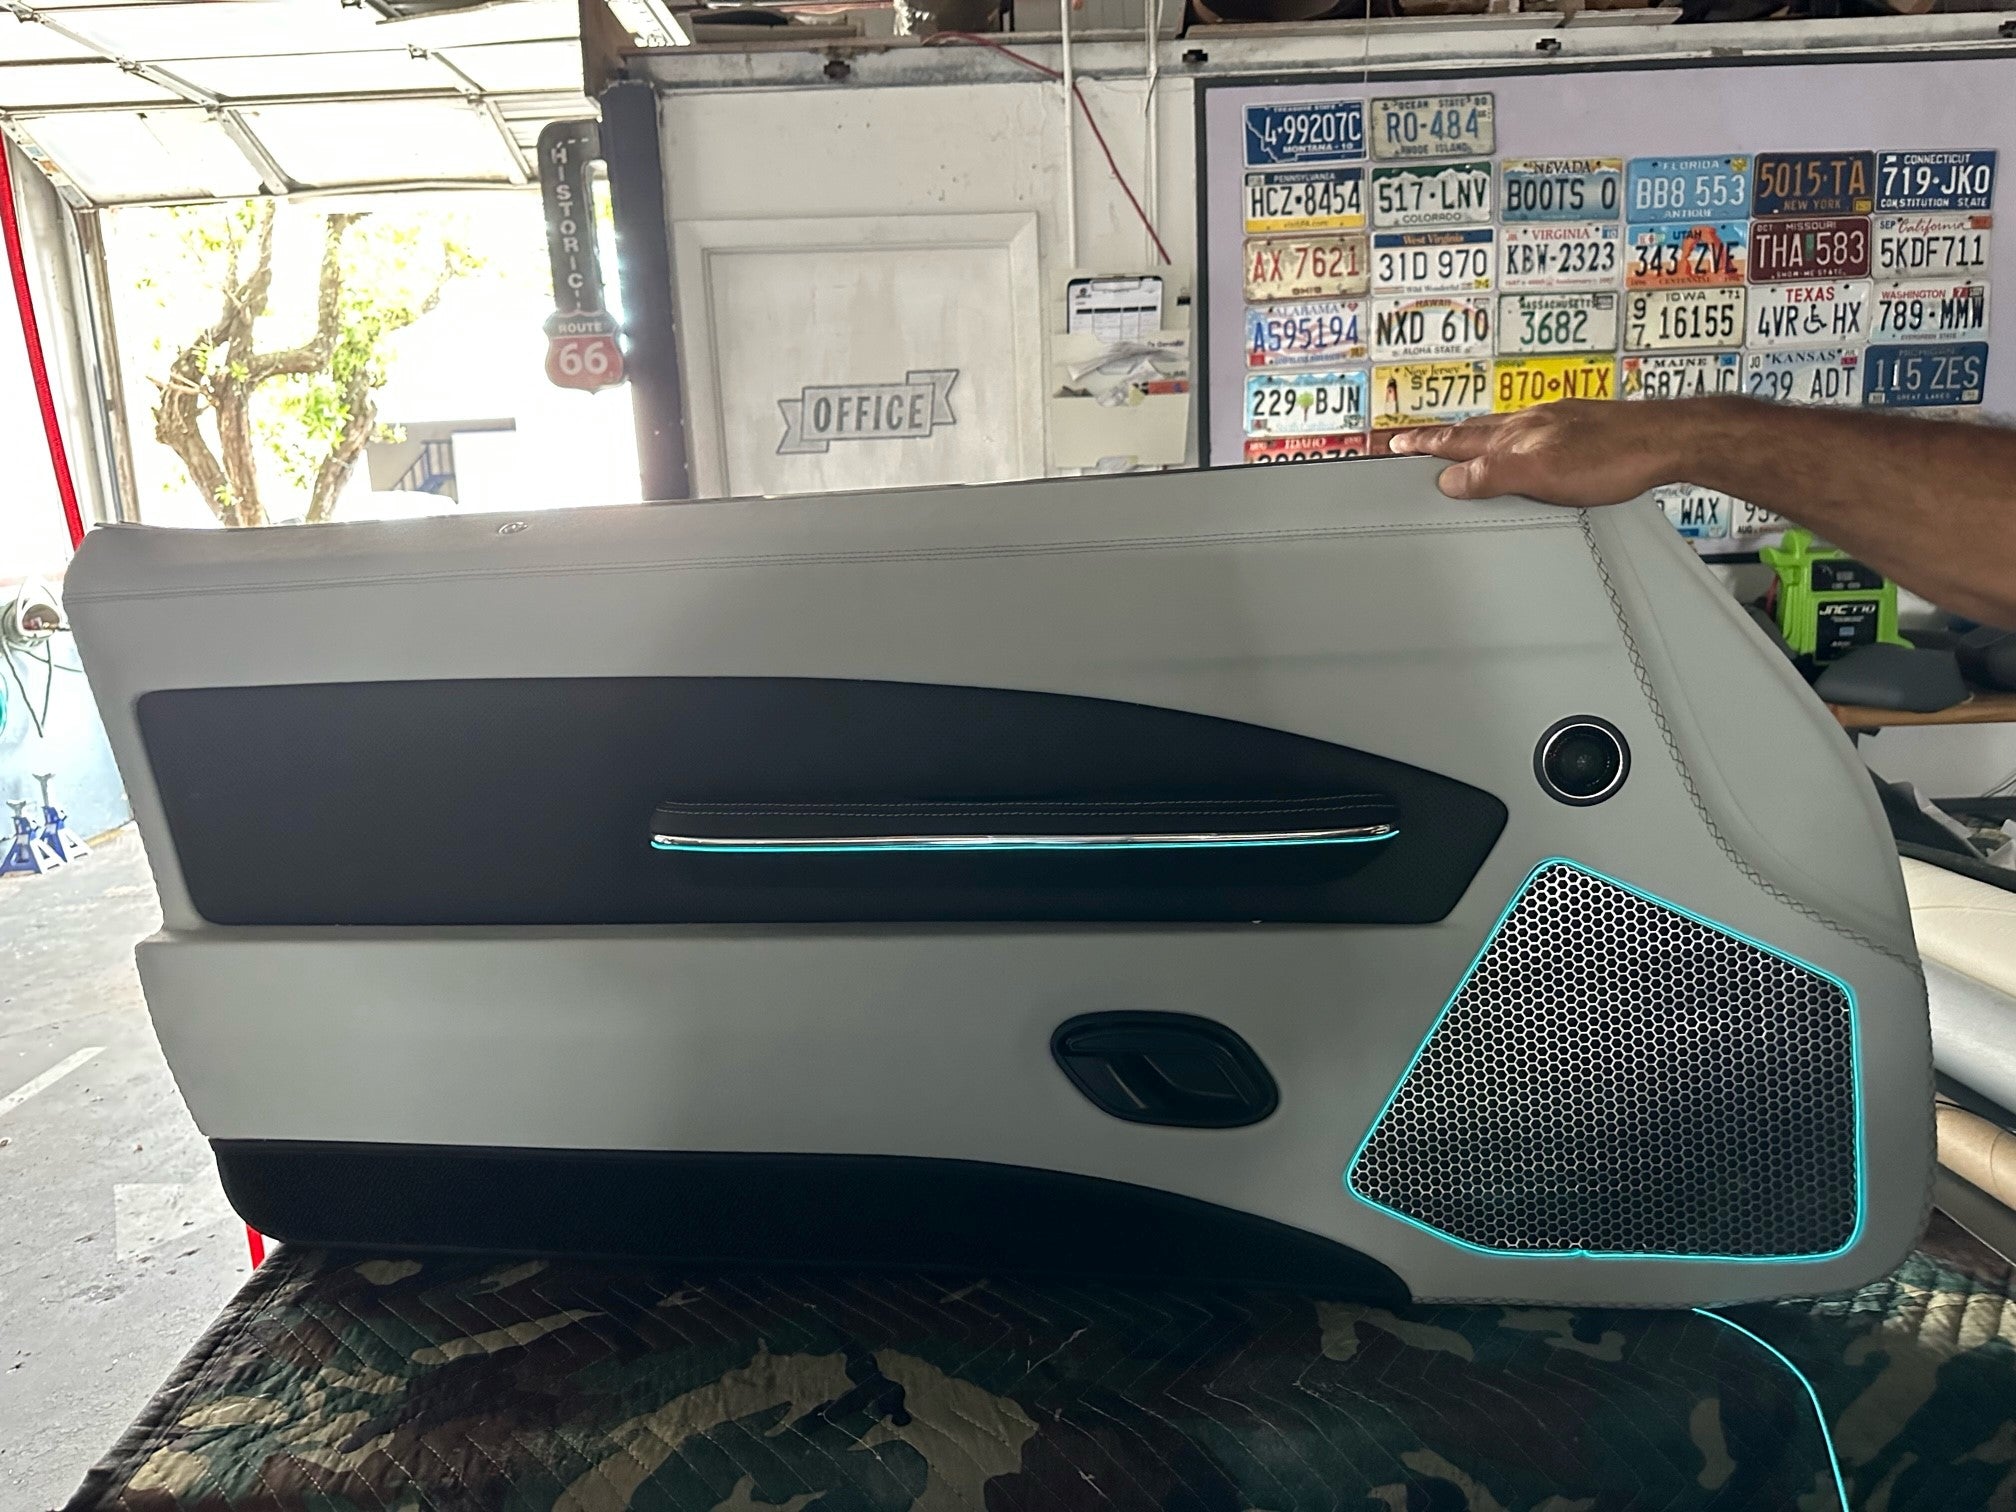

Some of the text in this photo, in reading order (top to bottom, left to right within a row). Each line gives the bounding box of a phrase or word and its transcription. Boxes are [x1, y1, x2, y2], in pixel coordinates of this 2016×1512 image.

[1282, 143, 1333, 153] MONTANA
[1533, 160, 1592, 174] NEVADA
[1662, 159, 1720, 170] FLORIDA
[1903, 154, 1971, 165] CONNECTICUT
[1273, 172, 1336, 183] PENNSYLVANIA
[1507, 178, 1584, 212] BOOTS
[1636, 174, 1745, 210] BB8 553
[1784, 200, 1841, 211] NEW YORK
[1880, 197, 1987, 209] CONSTITUTION STATE
[551, 147, 584, 288] HISTORIC
[1402, 212, 1462, 223] COLORADO
[1664, 208, 1713, 218] ANTIQUE
[1531, 228, 1591, 240] VIRGINIA
[1672, 230, 1702, 240] UTAH
[1757, 221, 1837, 232] OCT MISSOURI
[1879, 217, 1967, 237] SEP California
[1402, 234, 1465, 246] West Virginia
[1756, 230, 1865, 268] THA 583
[1506, 241, 1615, 275] KBW-2323
[1635, 241, 1740, 277] 343 ZVE
[1880, 234, 1985, 269] 5KDF711
[1252, 245, 1360, 283] AX 7621
[1379, 249, 1488, 282] 31D 970
[1415, 298, 1452, 308] HAWAII
[1665, 291, 1706, 302] IOWA
[1785, 287, 1836, 303] TEXAS
[1881, 289, 1947, 299] WASHINGTON
[1272, 303, 1341, 316] ALABAMA
[1633, 298, 1646, 320] 9
[558, 322, 602, 334] ROUTE
[1377, 309, 1489, 346] NXD 610
[1519, 310, 1588, 345] 3682
[1659, 304, 1734, 339] 16155
[1757, 302, 1862, 337] 4VR HX
[1632, 324, 1646, 347] 7
[559, 341, 609, 376] 66
[1402, 345, 1461, 355] ALOHA STATE
[1772, 349, 1836, 364] KANSAS
[1404, 364, 1460, 377] New Jersey
[1654, 358, 1708, 368] MAINE
[1875, 356, 1980, 391] 115 ZES
[1426, 374, 1486, 407] 577P
[1500, 367, 1611, 401] 870 NTX
[1750, 366, 1856, 400] 239 ADT
[1252, 385, 1361, 416] 229 BJN
[813, 394, 925, 433] OFFICE
[1284, 437, 1327, 449] IDAHO
[1680, 497, 1719, 525] WAX
